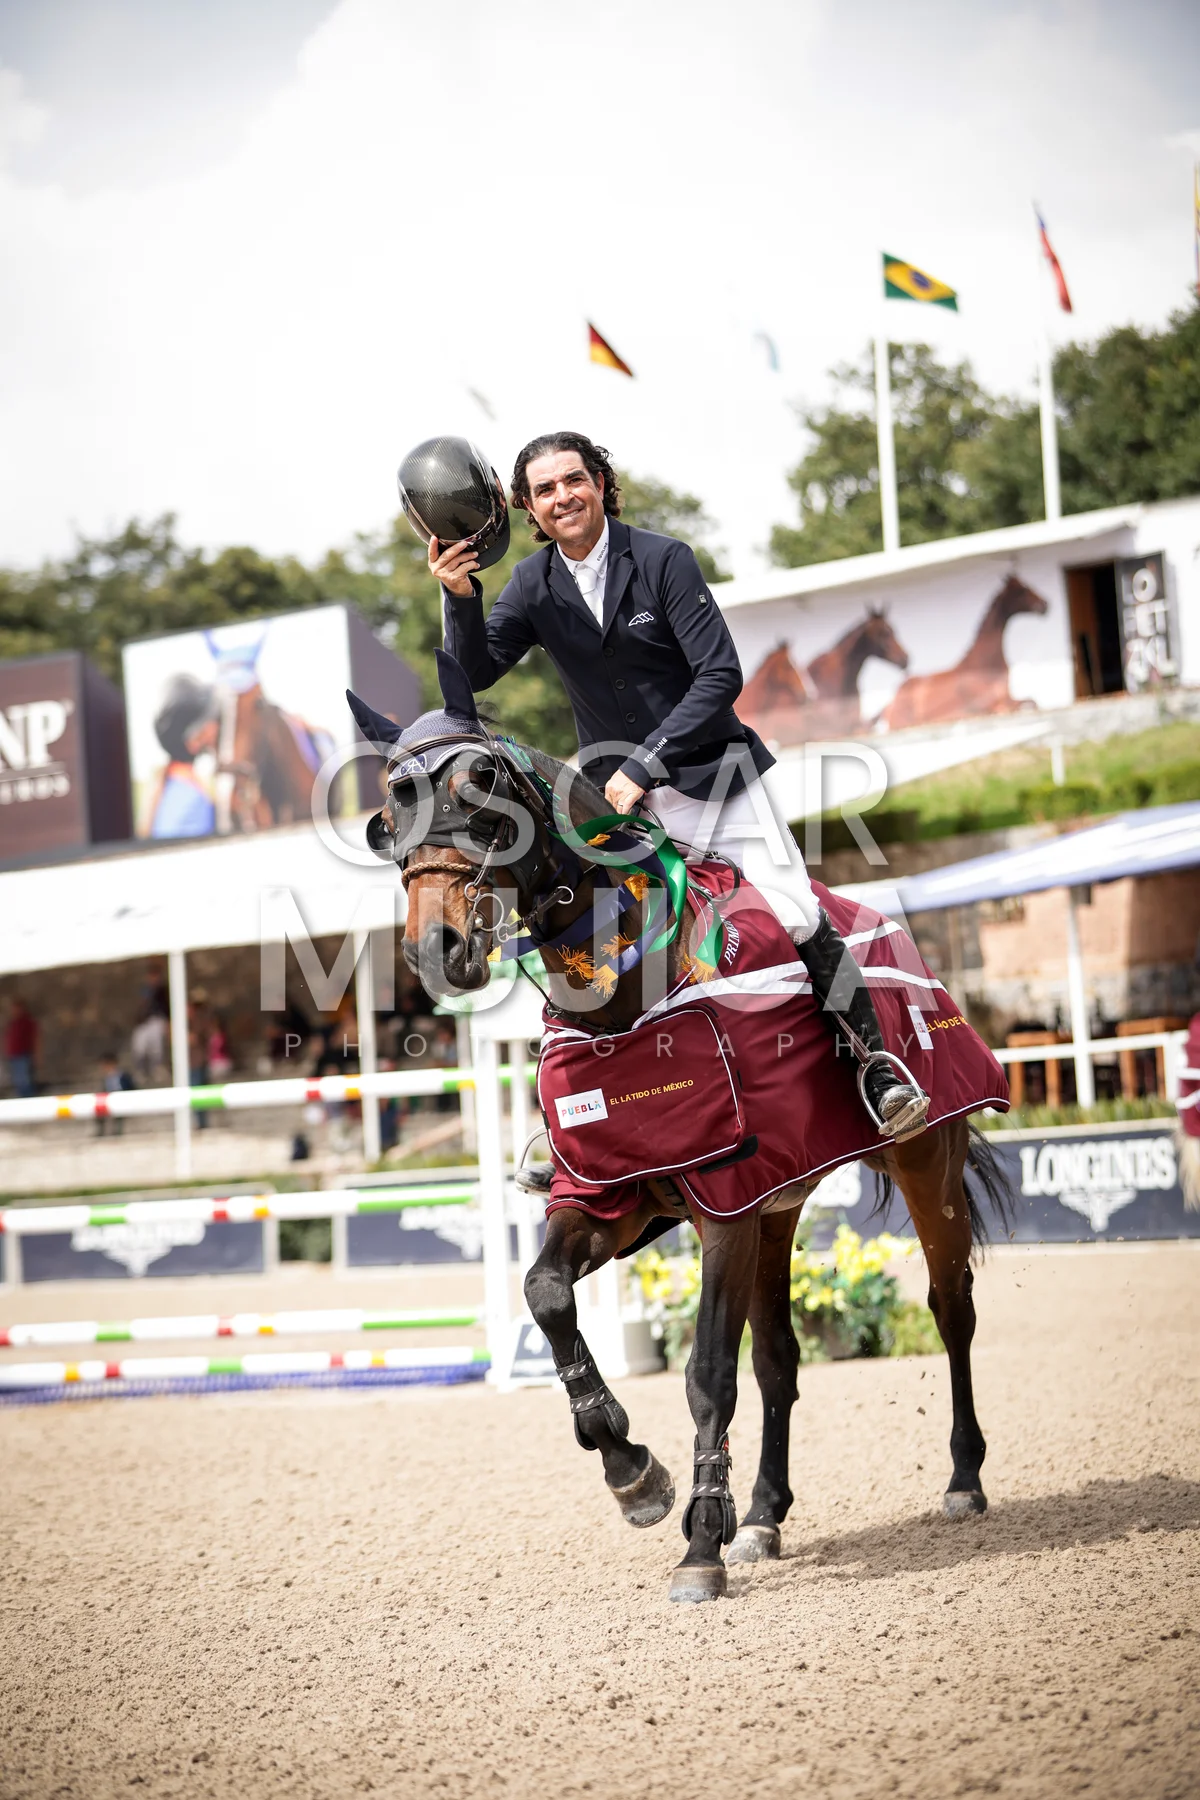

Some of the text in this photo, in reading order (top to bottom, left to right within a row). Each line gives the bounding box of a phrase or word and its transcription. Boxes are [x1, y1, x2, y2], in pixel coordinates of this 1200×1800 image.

[644, 737, 667, 763] EQUILINE
[609, 1079, 694, 1106] EL LATIDO DE MÉXICO
[561, 1101, 602, 1117] PUEBLA
[1019, 1137, 1177, 1197] LONGINES
